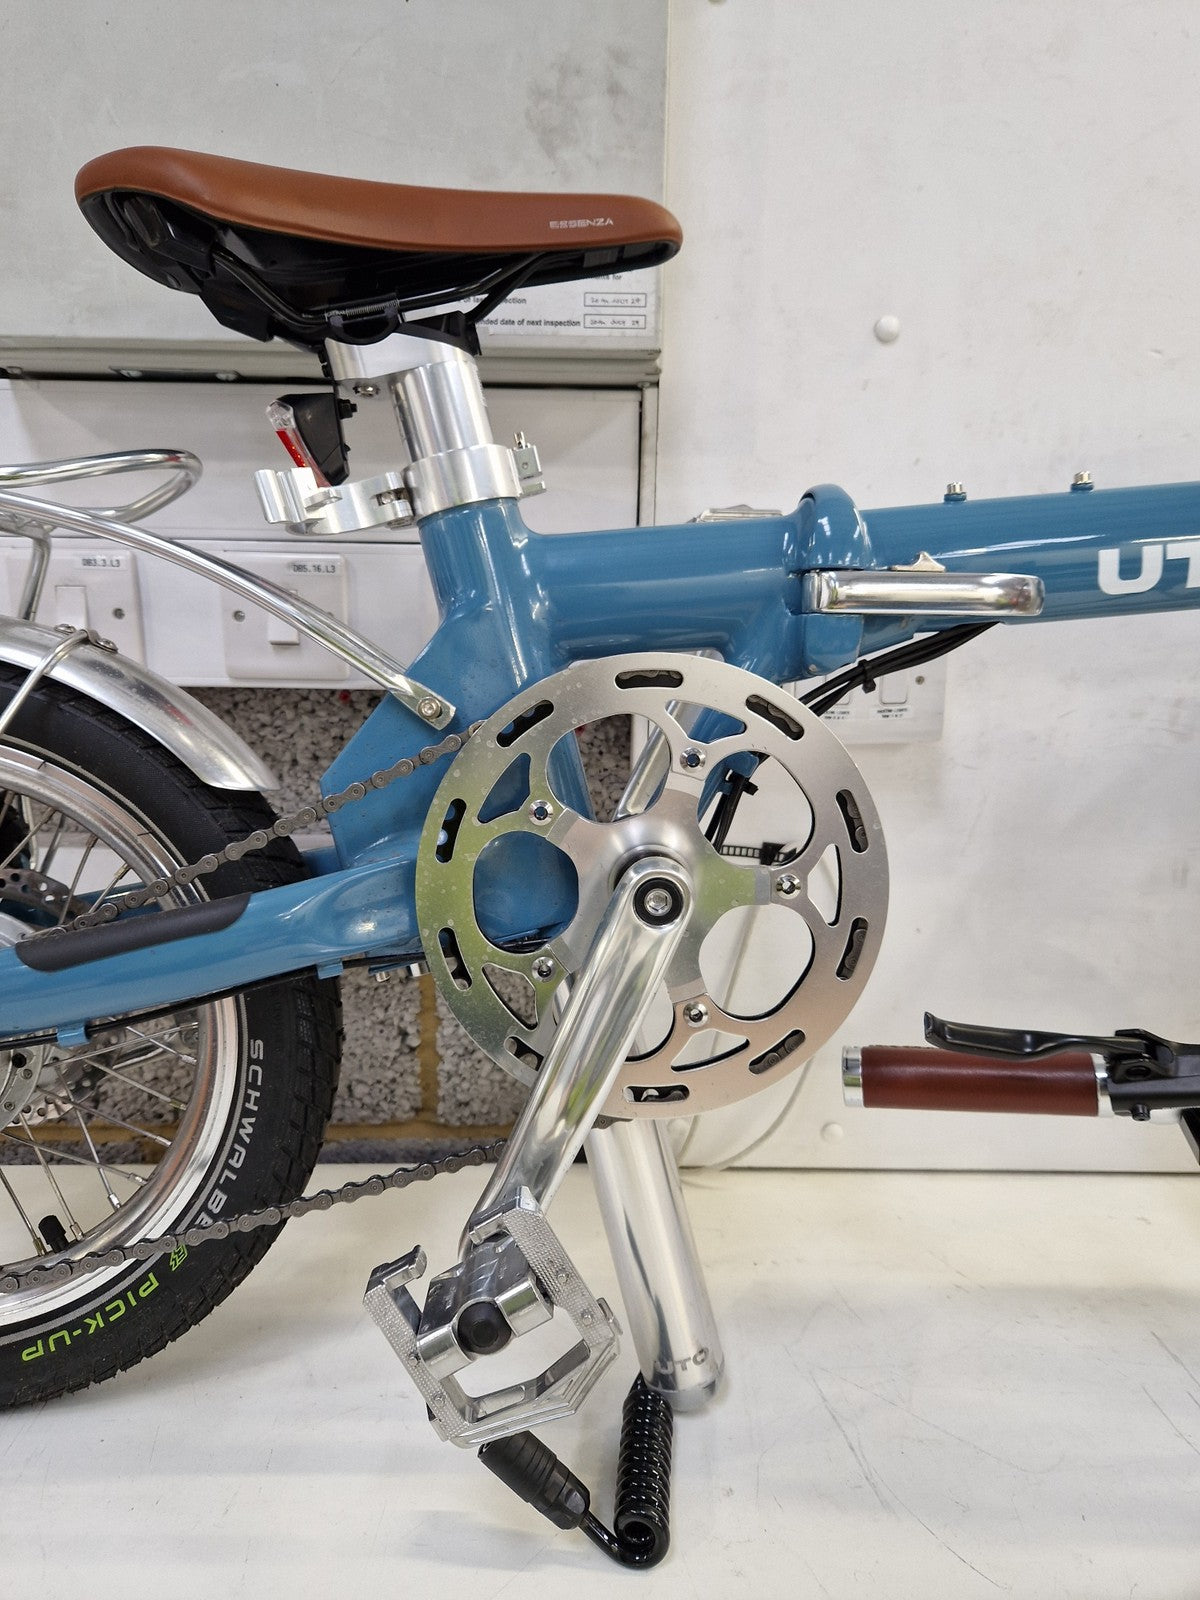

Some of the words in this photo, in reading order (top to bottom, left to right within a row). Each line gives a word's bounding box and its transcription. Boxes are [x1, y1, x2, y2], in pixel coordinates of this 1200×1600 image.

[549, 218, 614, 229] ESSENZA
[500, 318, 516, 326] date
[517, 318, 525, 326] of
[543, 319, 581, 328] inspection
[21, 1272, 160, 1362] PICK-UP
